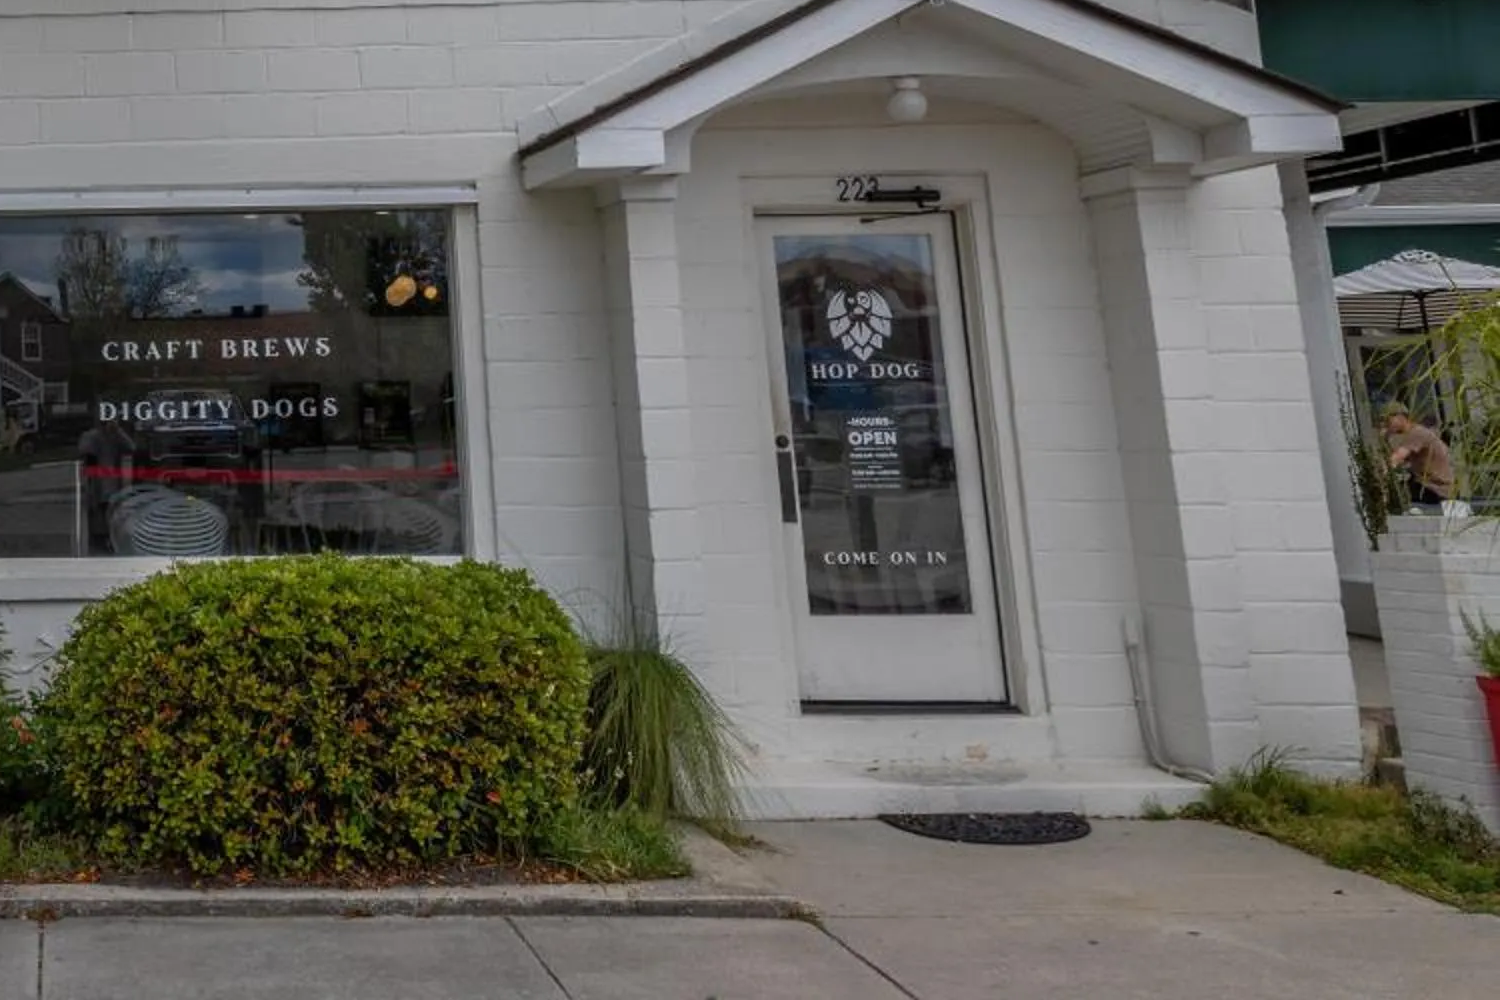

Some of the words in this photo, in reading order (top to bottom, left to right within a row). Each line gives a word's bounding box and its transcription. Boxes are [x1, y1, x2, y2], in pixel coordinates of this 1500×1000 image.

[101, 340, 203, 361] CRAFT
[221, 337, 331, 359] BREWS
[811, 363, 860, 379] HOP
[870, 363, 920, 379] DOG
[99, 399, 233, 421] DIGGITY
[252, 397, 339, 418] DOGS
[848, 431, 898, 446] OPEN
[823, 551, 880, 566] COME
[890, 551, 917, 566] ON
[927, 551, 948, 565] IN
